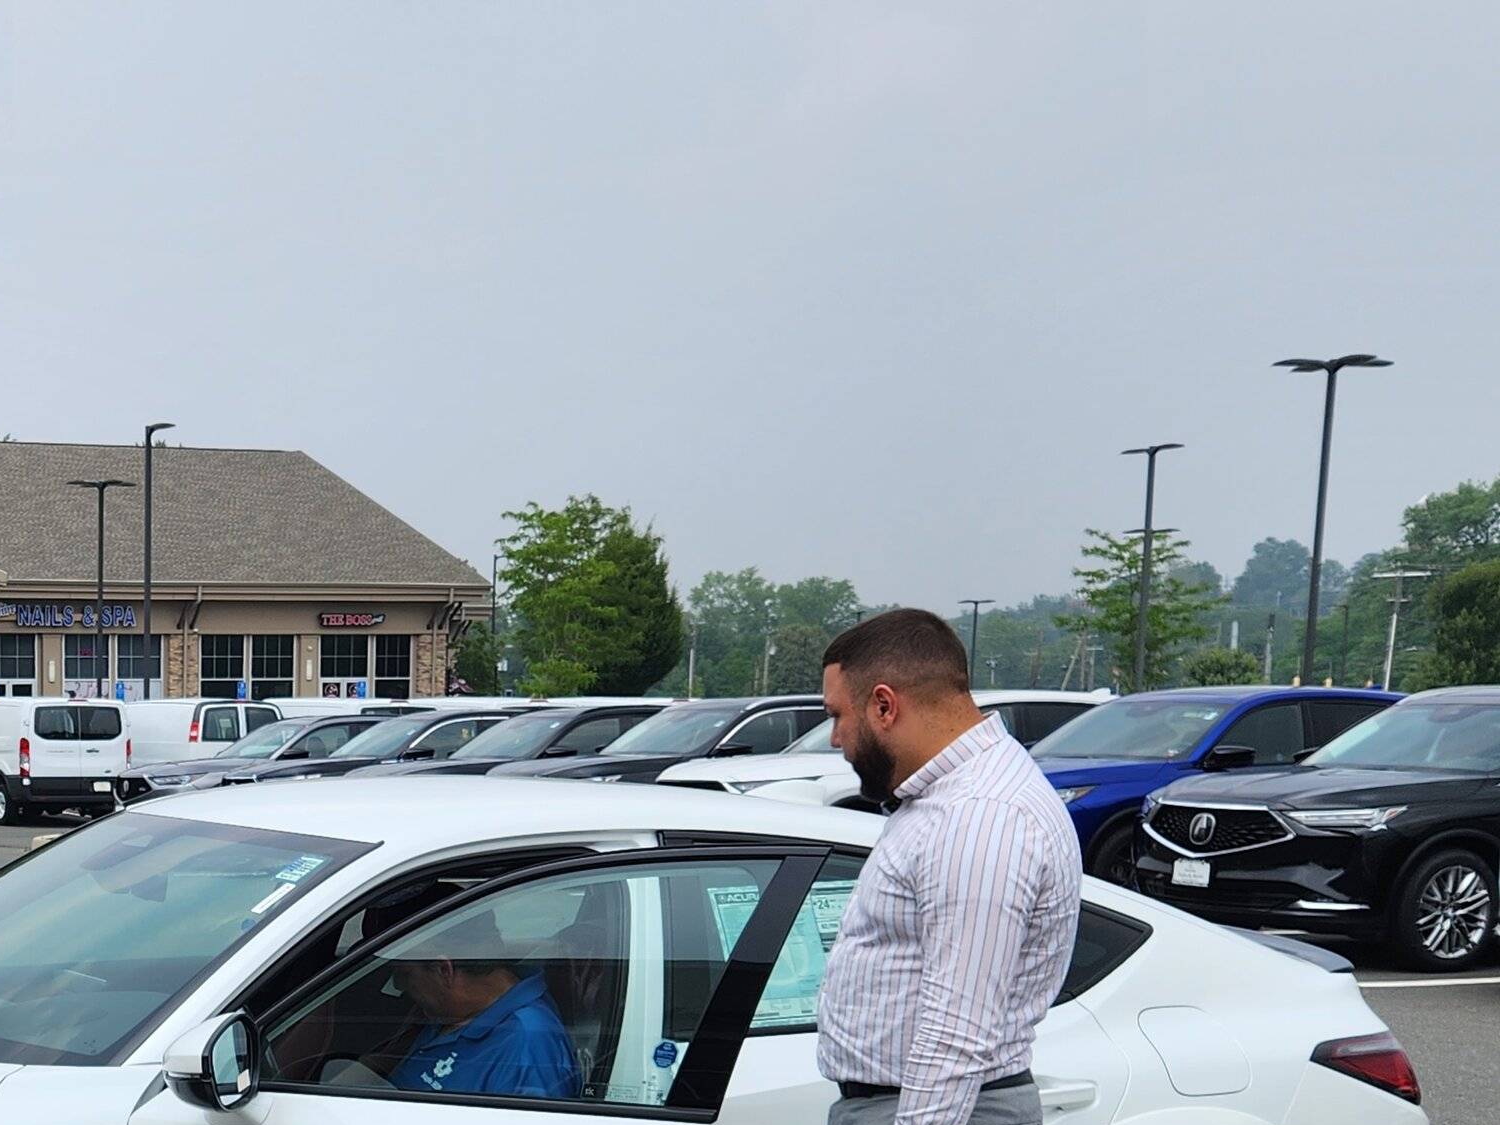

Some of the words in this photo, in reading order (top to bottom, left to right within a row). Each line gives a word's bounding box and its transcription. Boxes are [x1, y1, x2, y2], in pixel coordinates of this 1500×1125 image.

[16, 605, 75, 627] NAILS
[82, 604, 99, 628] &
[100, 605, 137, 627] SPA
[321, 614, 345, 626] THE
[345, 614, 373, 626] BOSS
